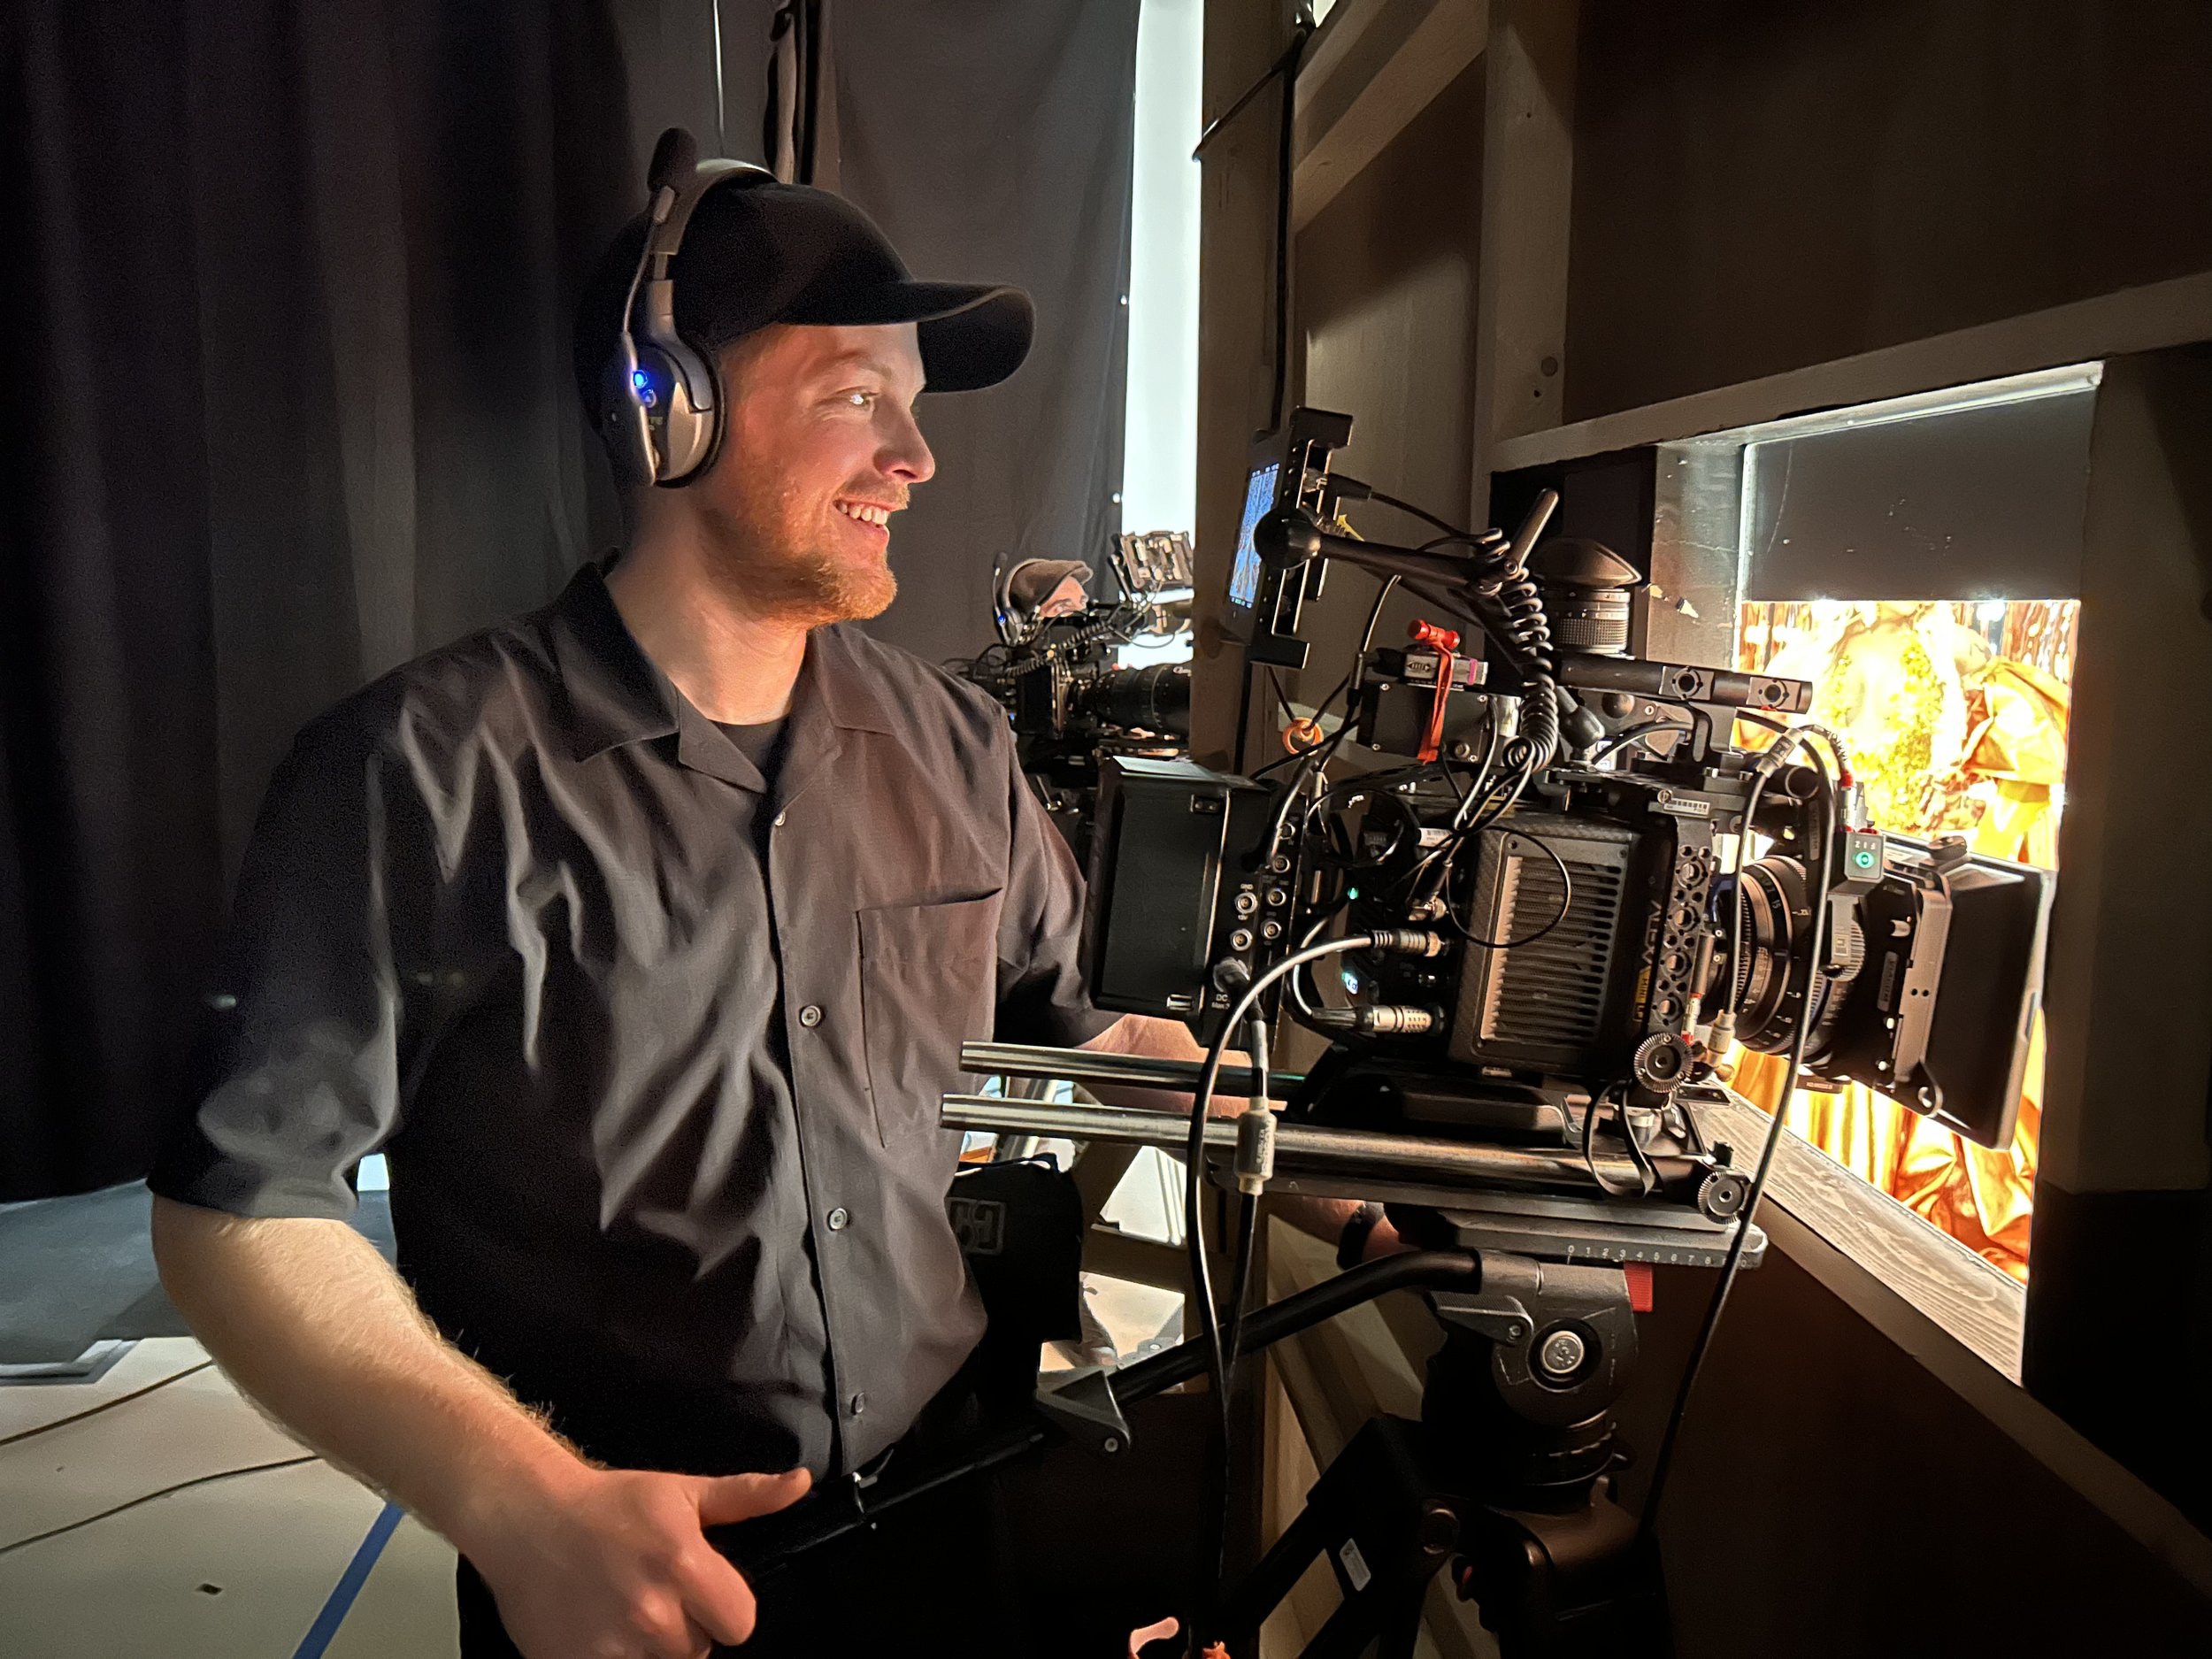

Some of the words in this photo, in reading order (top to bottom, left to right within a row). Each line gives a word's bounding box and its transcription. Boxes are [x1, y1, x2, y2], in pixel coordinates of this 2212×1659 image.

[1642, 899, 1663, 964] ALEXA
[1216, 993, 1228, 1002] DC
[1568, 1245, 1575, 1254] 0
[1602, 1248, 1609, 1256] 2
[1654, 1252, 1660, 1261] 5
